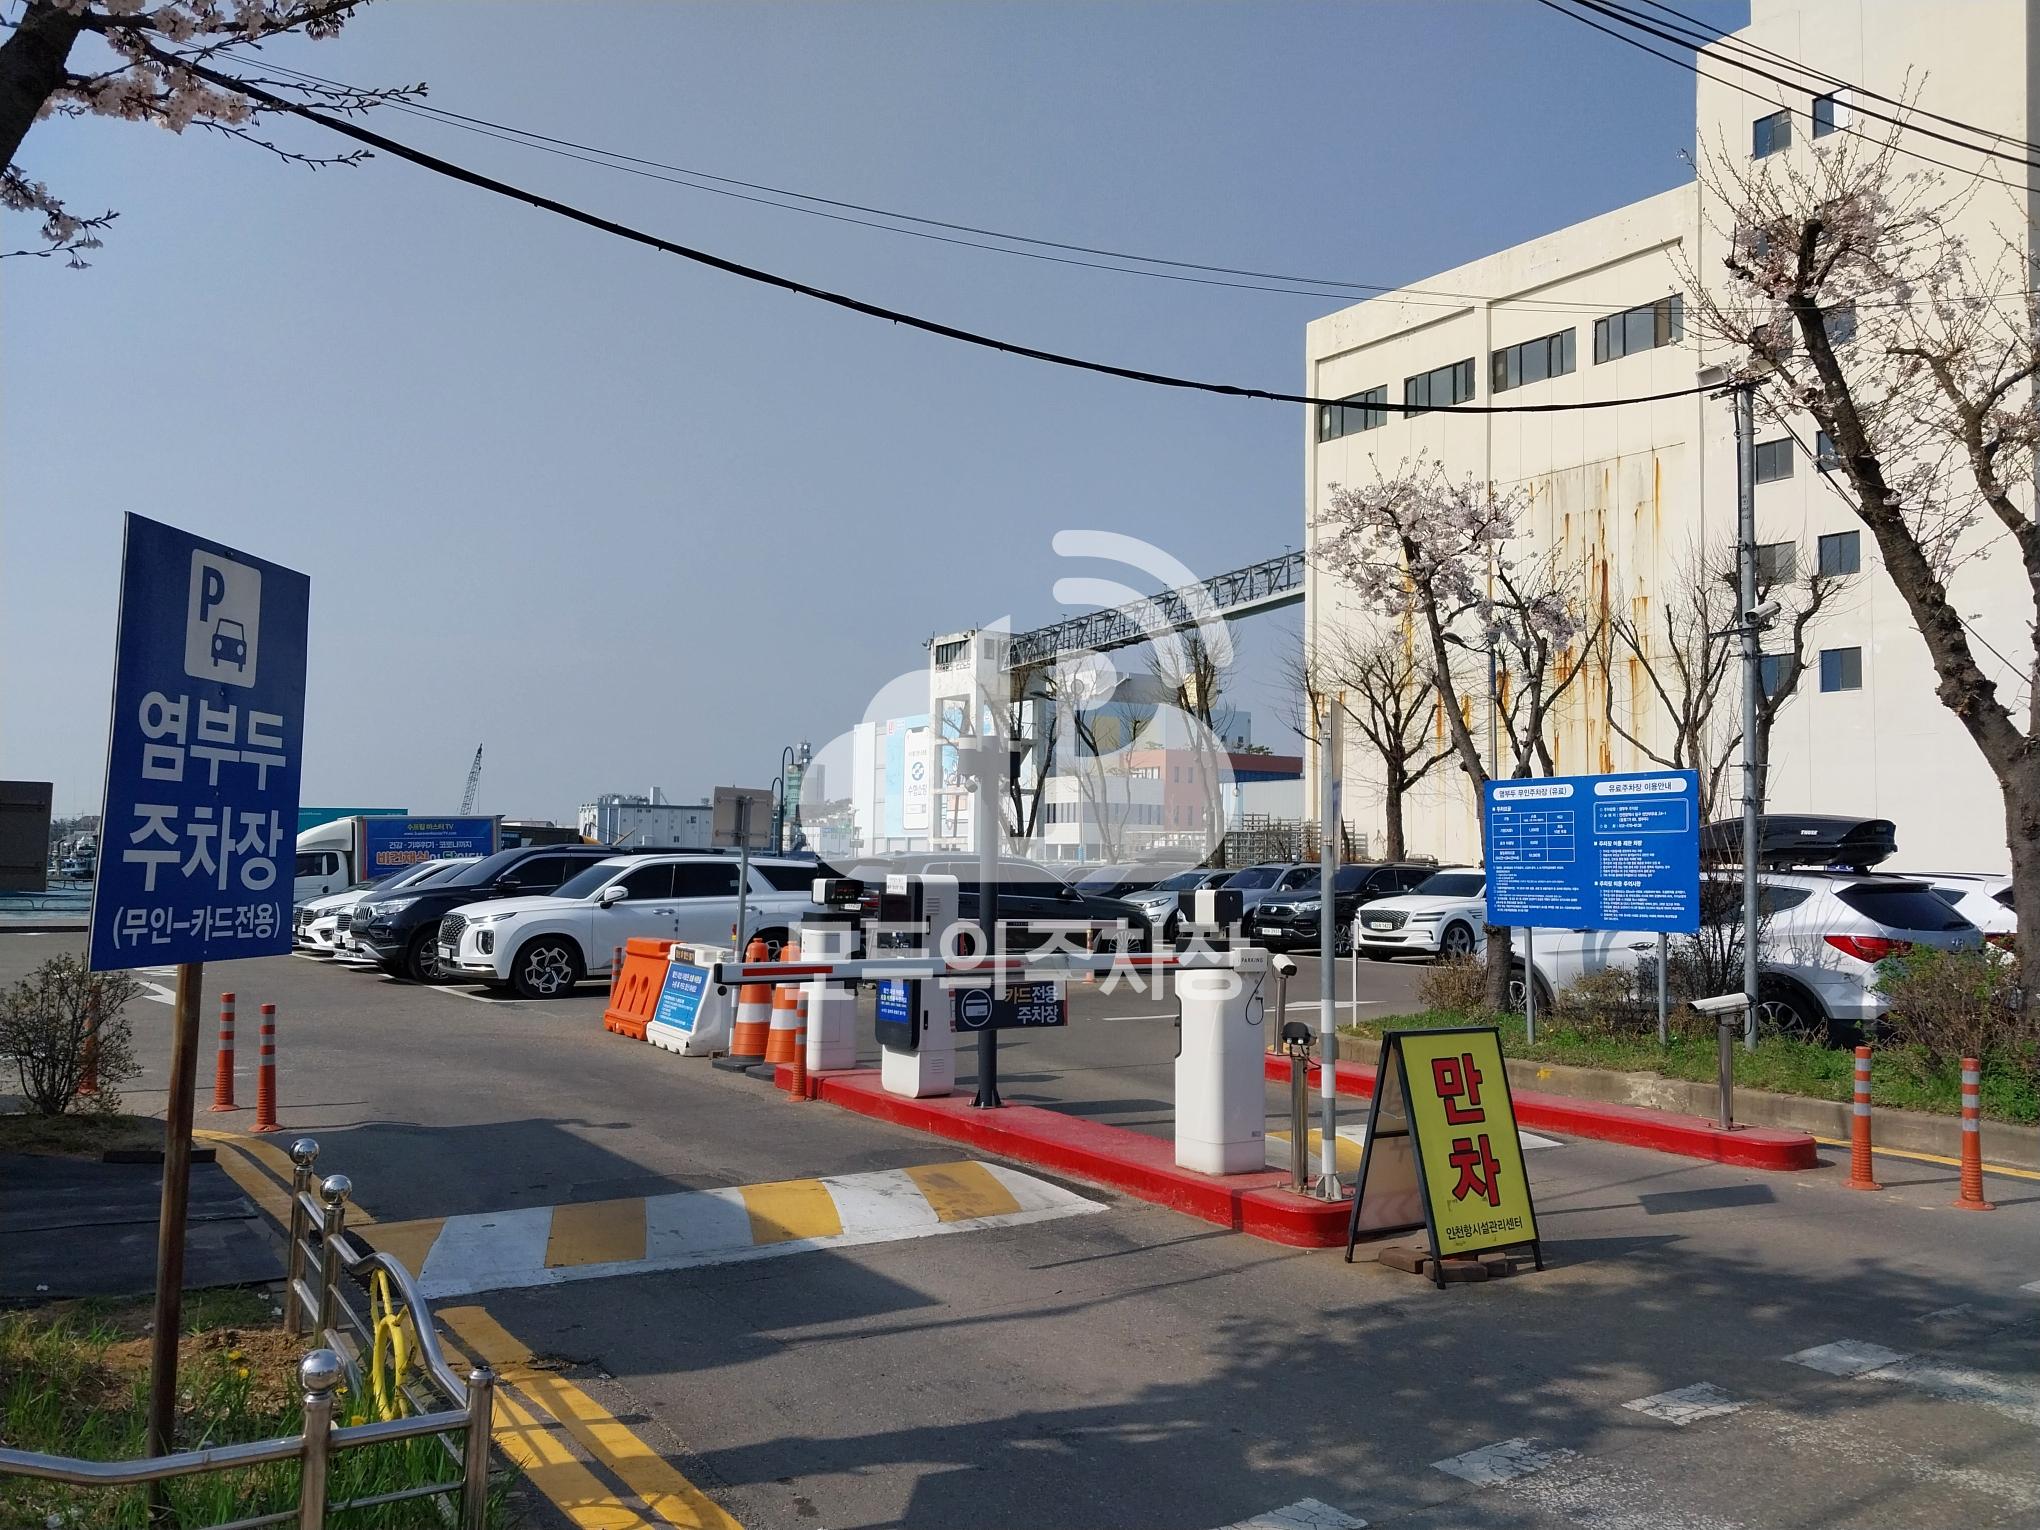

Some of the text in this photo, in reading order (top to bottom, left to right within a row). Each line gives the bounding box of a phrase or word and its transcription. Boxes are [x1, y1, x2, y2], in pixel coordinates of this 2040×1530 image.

[200, 565, 225, 622] P
[138, 690, 287, 791] 염부두
[1518, 788, 1548, 797] 무인주차장
[1549, 787, 1567, 796] (유료)
[1608, 781, 1672, 793] 유료주차장 이용안내
[445, 823, 455, 831] TV
[123, 803, 283, 892] 주차장
[407, 841, 435, 849] 기후위기
[439, 840, 472, 849] 코로나까지
[112, 902, 280, 949] (무인-카드전용)
[1005, 985, 1058, 1004] 카드전용
[1017, 1005, 1059, 1024] 주차장
[1431, 1053, 1501, 1207] 만차
[1446, 1216, 1523, 1241] 인천항시설관리센터
